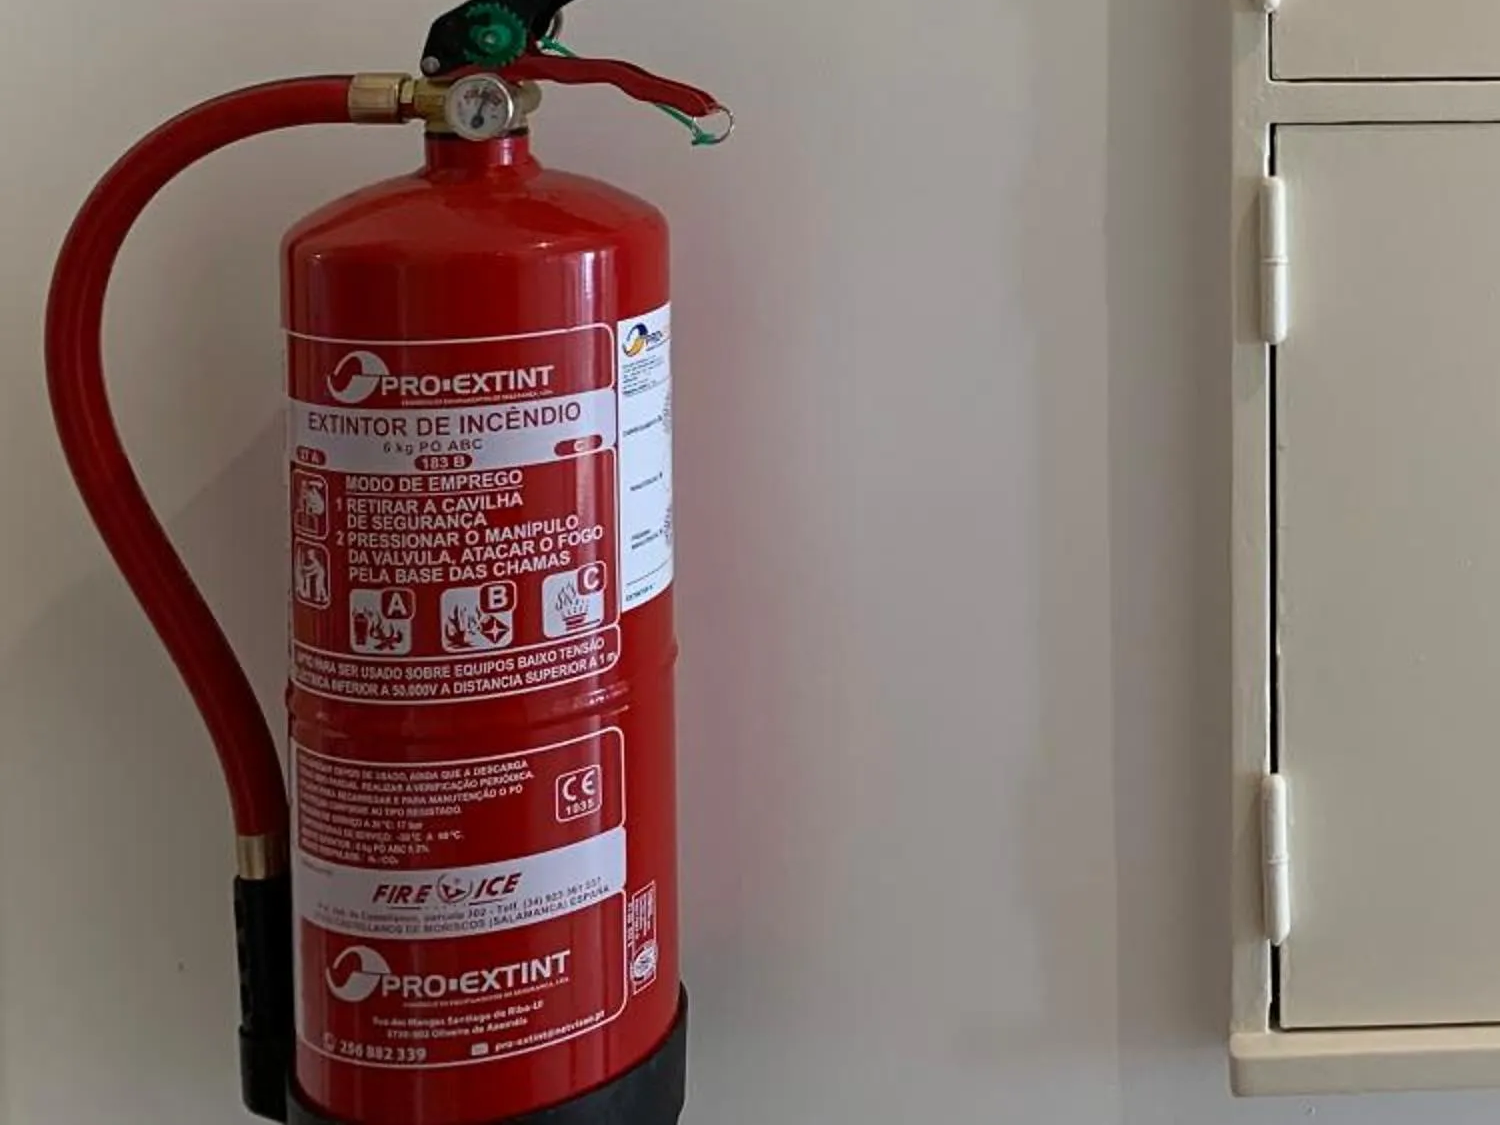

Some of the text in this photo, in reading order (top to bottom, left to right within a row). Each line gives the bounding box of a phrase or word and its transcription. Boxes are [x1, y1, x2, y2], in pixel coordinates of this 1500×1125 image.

[308, 401, 581, 437] EXTINTOR DE INCÊNDIO
[447, 438, 483, 452] ABC
[421, 453, 465, 470] 183 B
[345, 469, 523, 492] MODO DE EMPREGO
[335, 491, 524, 515] 1 RETIRAR A CAVILHA
[347, 511, 488, 531] DE SEGURANÇA
[336, 530, 345, 546] 2
[347, 530, 459, 549] PRESSIONAR
[465, 530, 479, 545] O
[349, 549, 369, 565] DA
[461, 540, 535, 564] ATACAR
[540, 538, 553, 552] O
[558, 525, 603, 549] FOGO
[349, 550, 571, 583] PELA BASE DAS CHAMAS
[583, 566, 600, 590] C
[387, 592, 408, 616] A
[488, 586, 508, 610] B
[361, 665, 402, 680] USADO
[405, 666, 450, 680] SOBRE
[454, 659, 515, 677] EQUIPOS
[517, 649, 558, 669] BAIXO
[560, 636, 605, 660] TENSÃO
[380, 683, 390, 696] A
[440, 682, 450, 695] A
[525, 661, 587, 684] SUPERIOR
[589, 659, 598, 673] A
[600, 653, 605, 665] 1
[441, 768, 460, 780] QUE
[463, 767, 472, 778] A
[473, 758, 529, 776] DESCARGA
[499, 786, 507, 797] O
[371, 872, 522, 905] FIRE ICE
